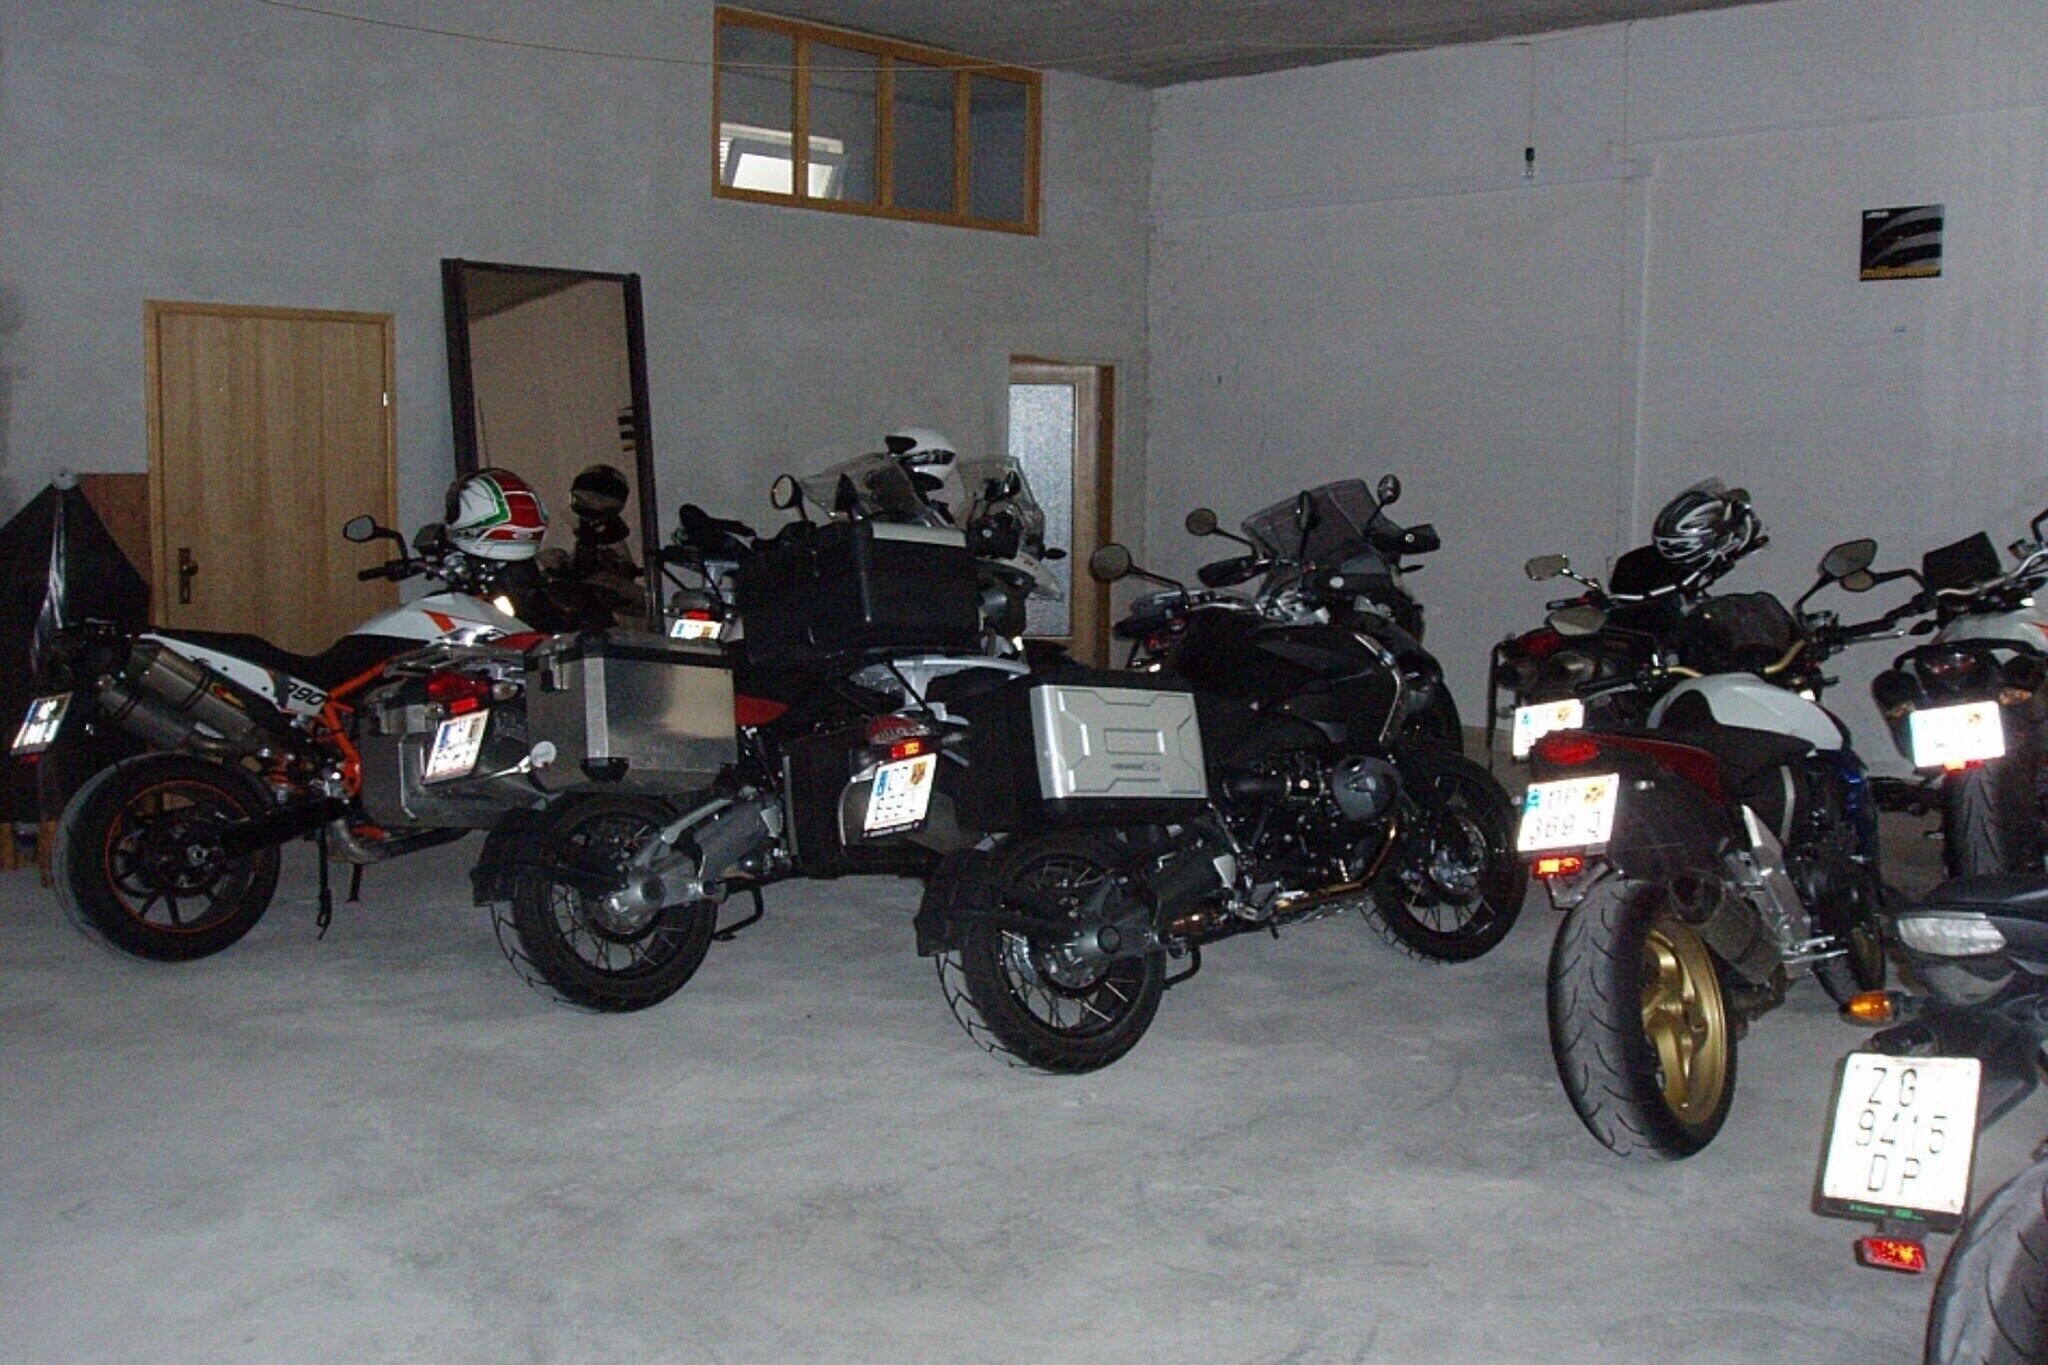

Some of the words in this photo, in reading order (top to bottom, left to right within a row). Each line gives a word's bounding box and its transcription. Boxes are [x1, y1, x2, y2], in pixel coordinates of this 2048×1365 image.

[1868, 1066, 1918, 1108] ZG
[1855, 1108, 1949, 1155] 9415
[1866, 1153, 1922, 1196] DP
